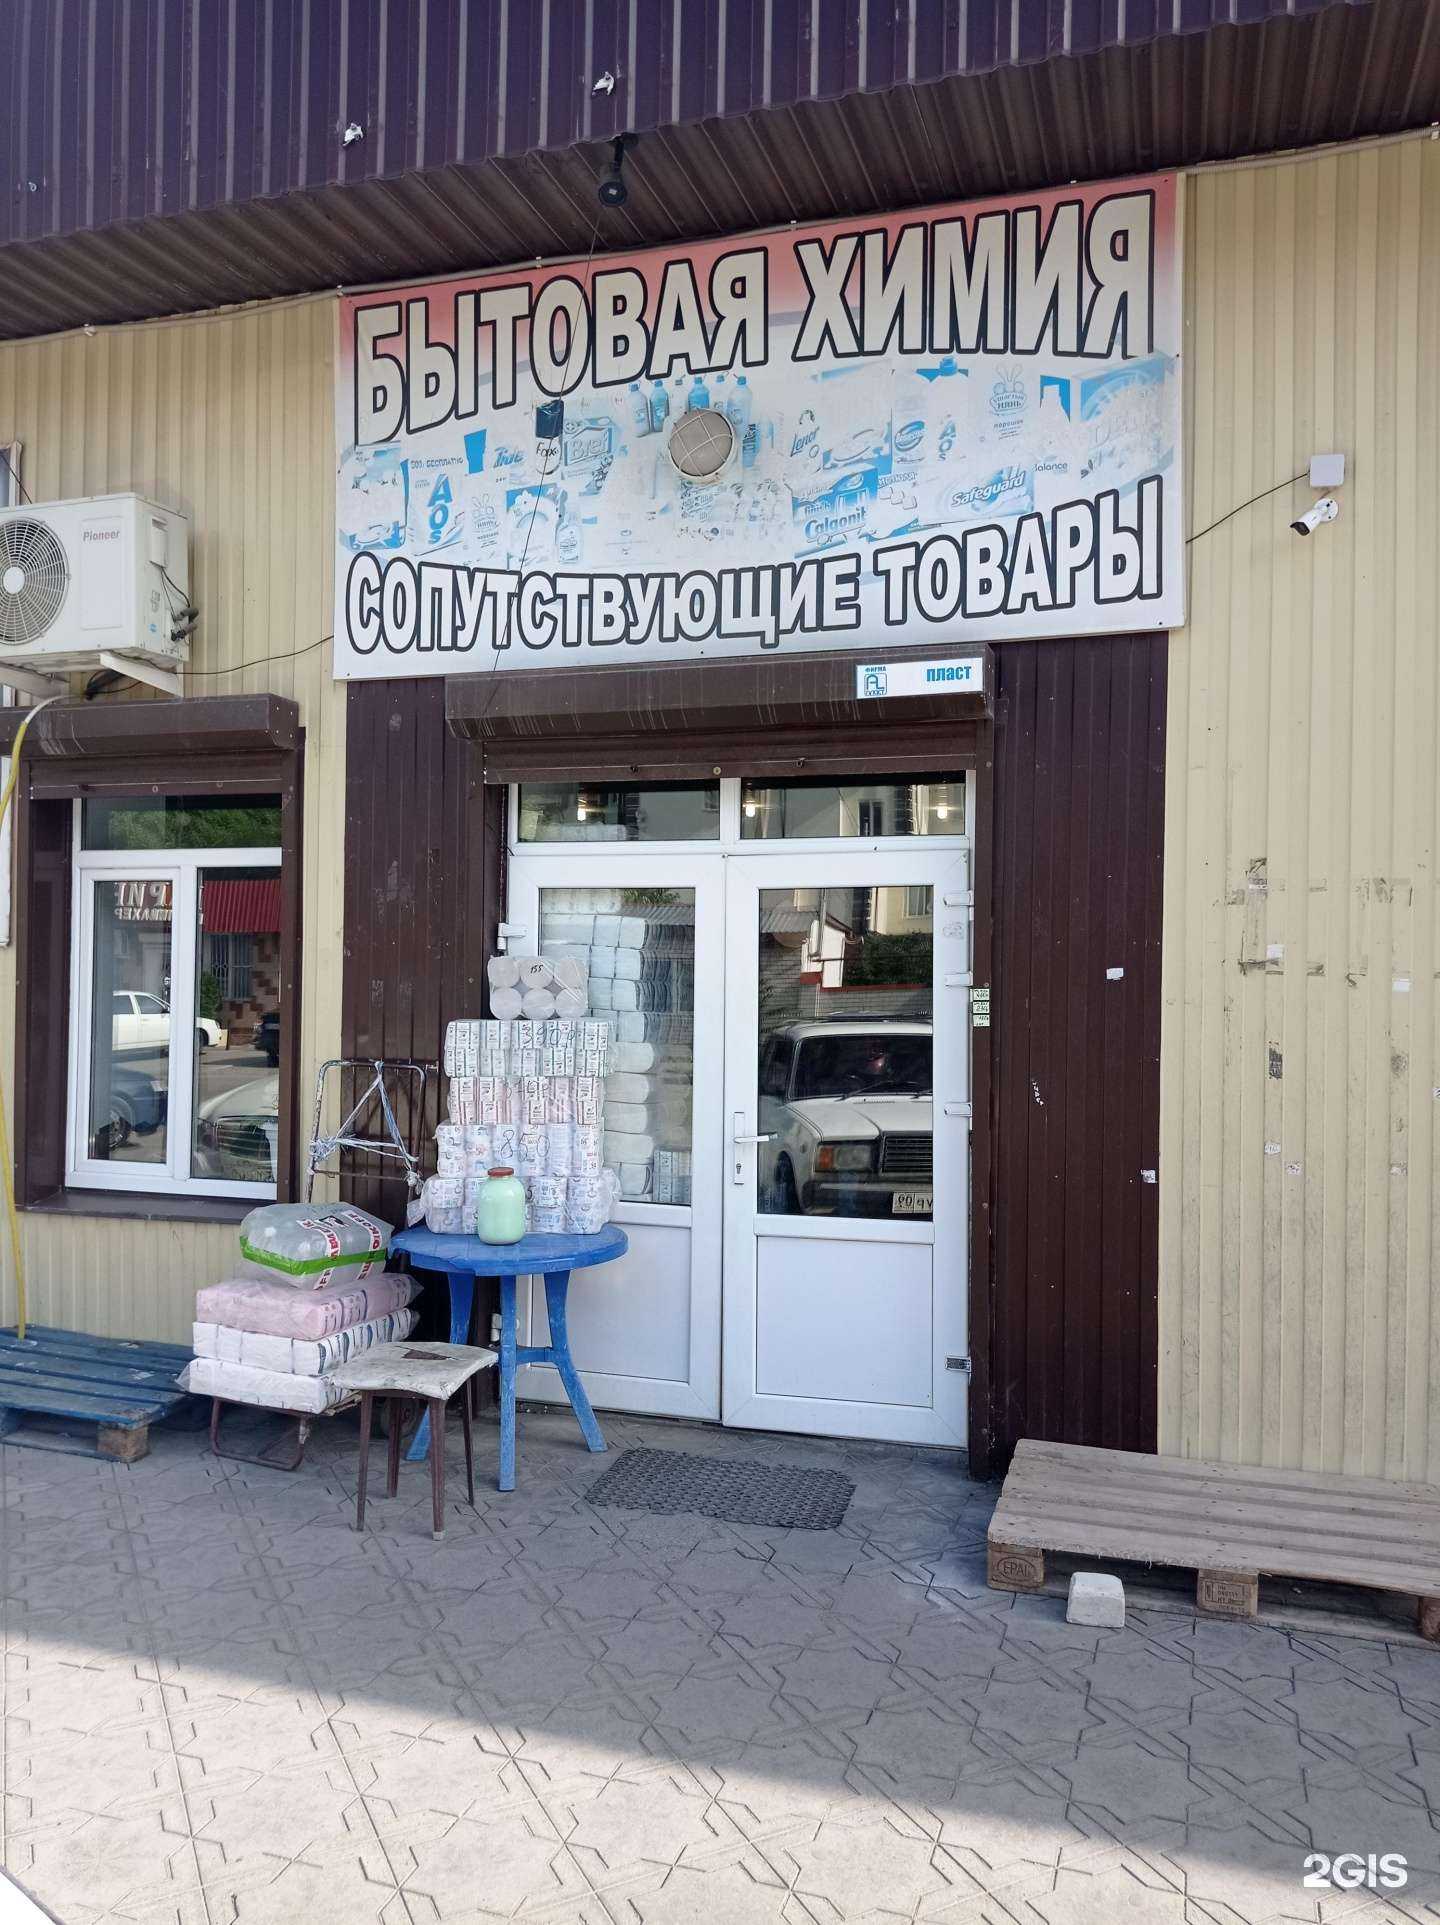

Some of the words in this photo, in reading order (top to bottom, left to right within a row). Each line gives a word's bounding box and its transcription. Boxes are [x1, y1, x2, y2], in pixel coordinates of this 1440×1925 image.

[355, 246, 770, 446] БЫТОВАЯ
[791, 188, 1156, 362] ХИМИЯ
[428, 473, 453, 544] AOS
[951, 469, 1027, 508] Safeguard
[83, 530, 120, 541] Pioneer
[805, 506, 866, 540] Calgonit
[346, 551, 862, 654] СОПУТСТВУЮЩИЕ
[873, 474, 1163, 626] ТОВАРЫ
